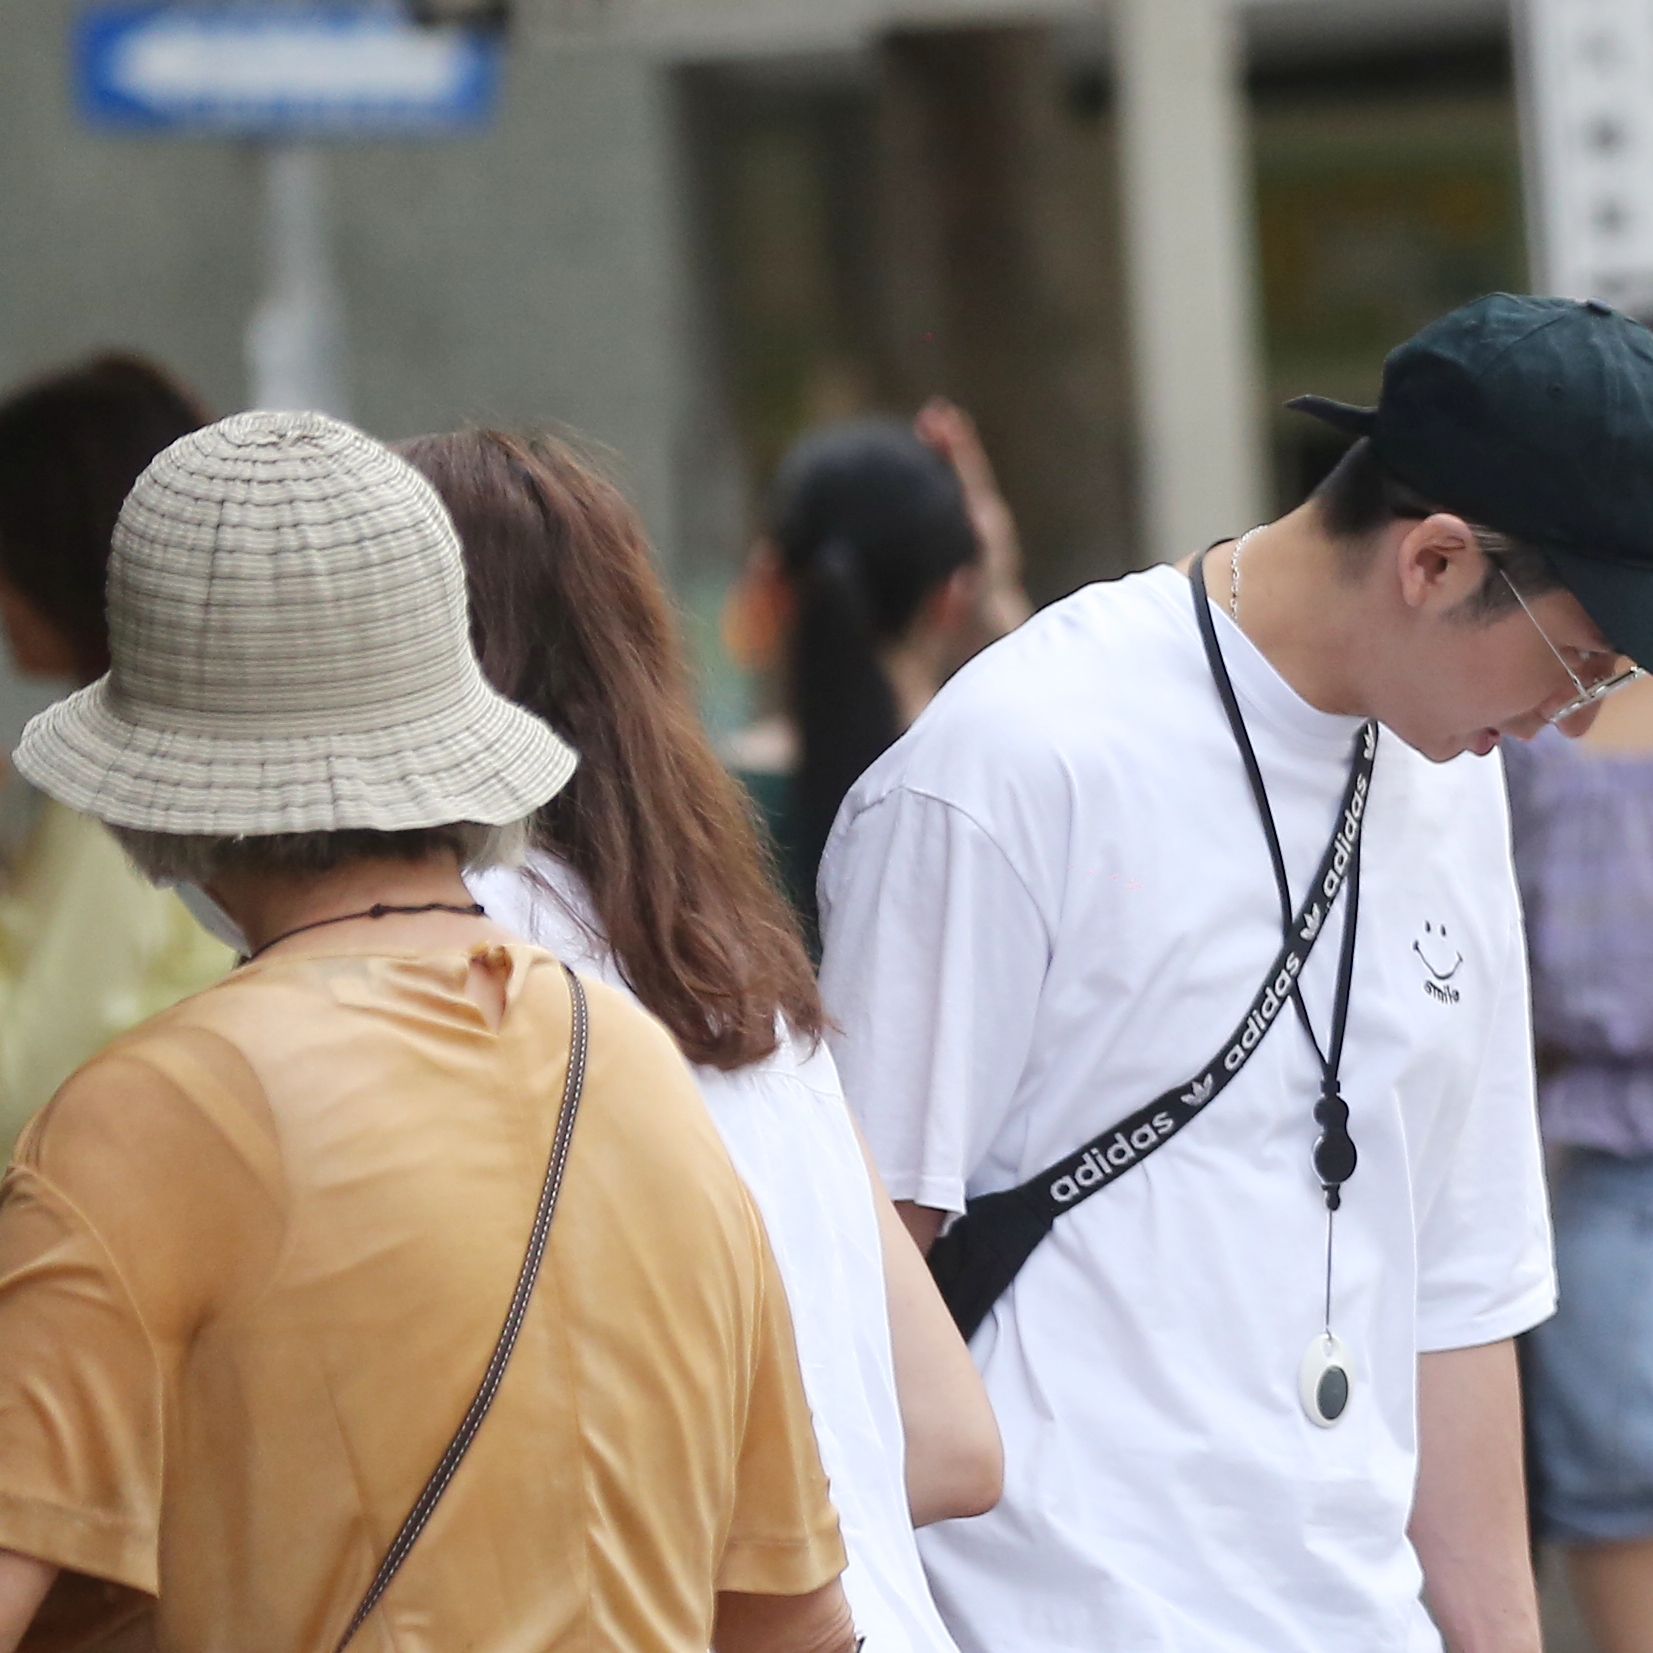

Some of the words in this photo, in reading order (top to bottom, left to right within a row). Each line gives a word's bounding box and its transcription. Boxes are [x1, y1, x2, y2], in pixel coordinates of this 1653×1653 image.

[1322, 772, 1367, 897] adidas
[1224, 951, 1300, 1072] adidas
[1424, 980, 1460, 1004] smile
[1050, 1111, 1175, 1202] adidas
